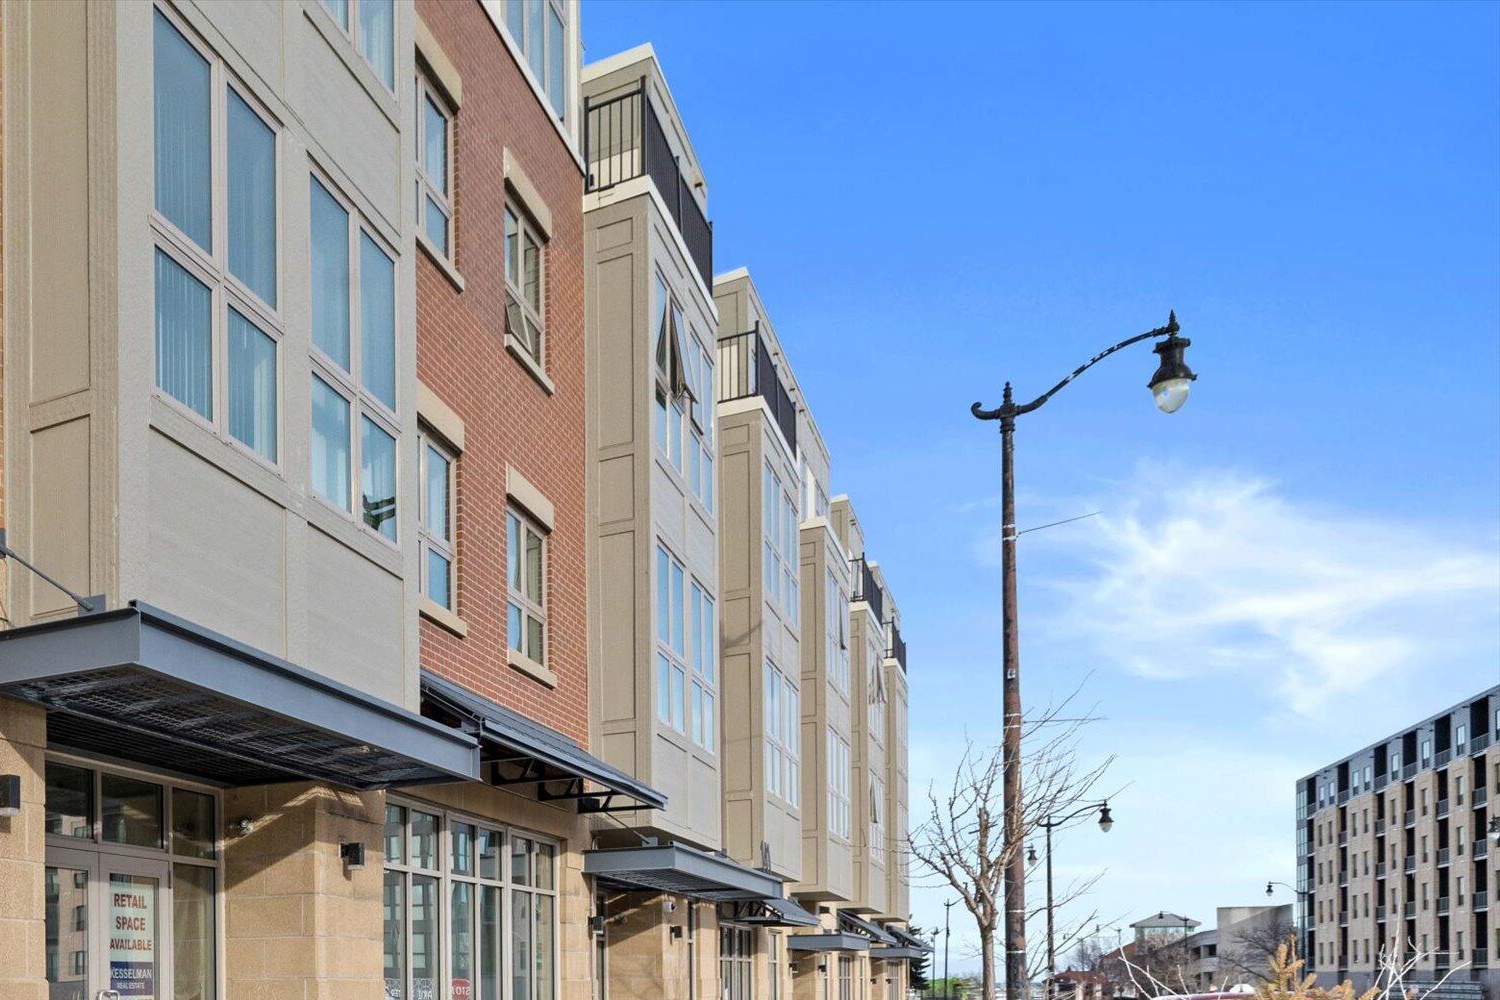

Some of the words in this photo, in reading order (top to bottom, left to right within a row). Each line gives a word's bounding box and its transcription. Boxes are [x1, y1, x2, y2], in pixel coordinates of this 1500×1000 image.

[114, 893, 147, 909] RETAIL
[116, 916, 146, 931] SPACE
[110, 938, 152, 951] AVAILABLE
[129, 982, 146, 990] ESTATE
